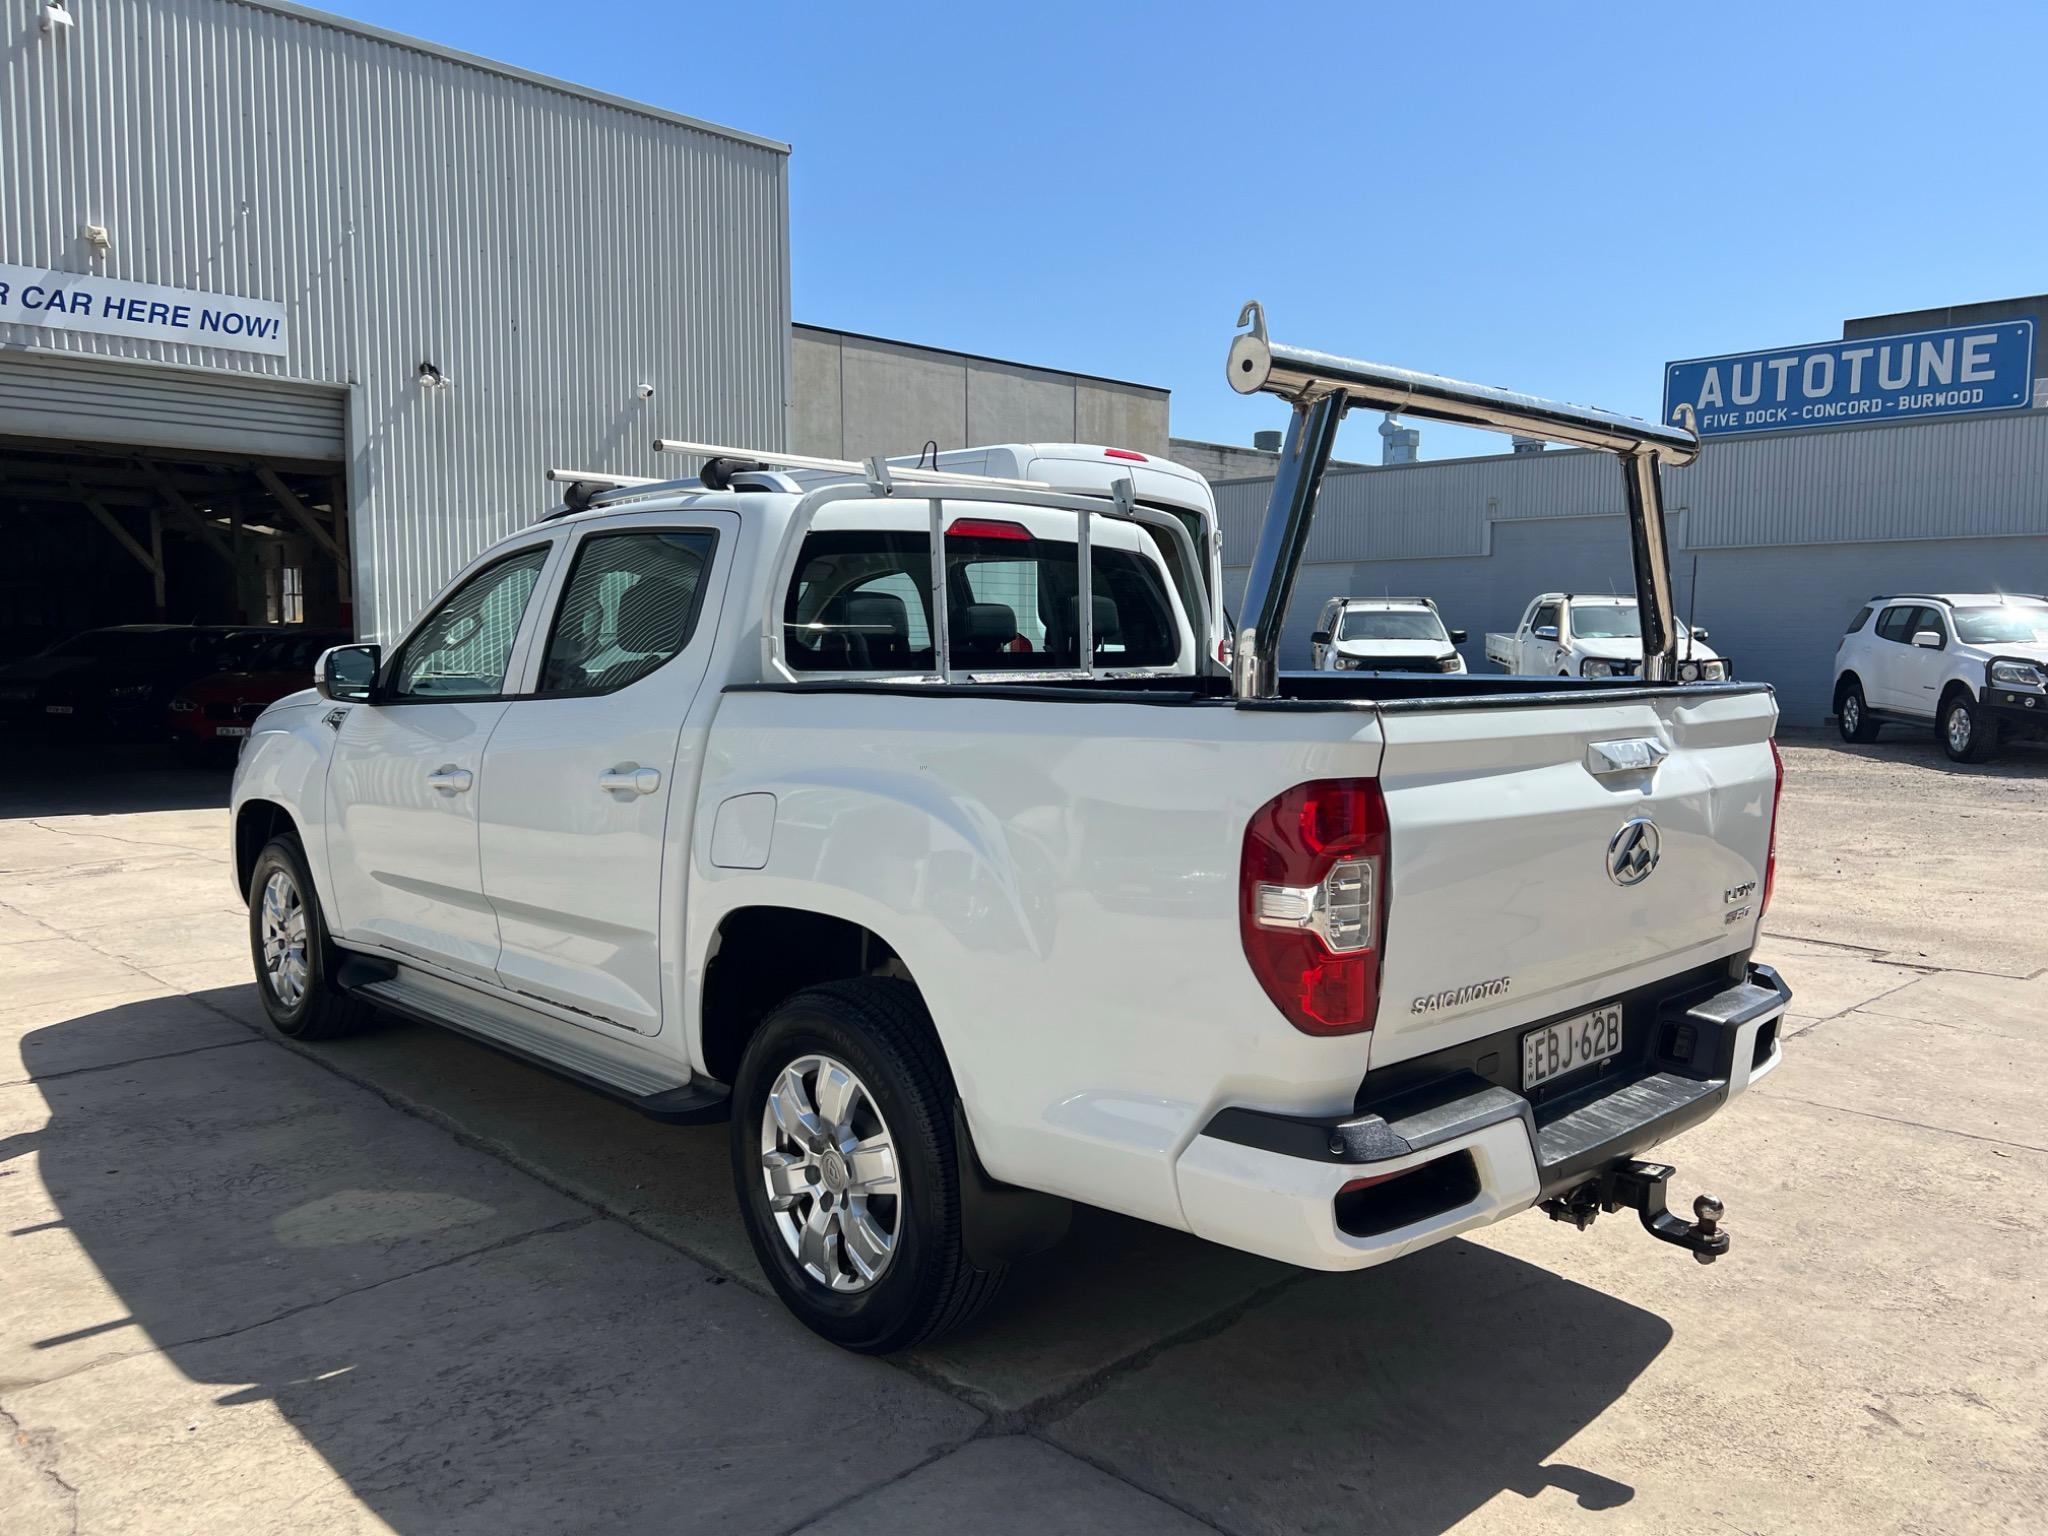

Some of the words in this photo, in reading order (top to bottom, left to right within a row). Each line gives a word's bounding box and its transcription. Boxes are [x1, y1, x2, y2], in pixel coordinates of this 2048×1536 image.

[21, 285, 93, 316] CAR
[102, 296, 191, 328] HERE
[199, 309, 280, 340] NOW!
[1696, 333, 1999, 410] AUTOTUNE
[1703, 412, 1739, 429] FIVE
[1745, 408, 1788, 425] DOCK
[1802, 398, 1882, 420] CONCORD
[1898, 388, 1984, 410] BURWOOD
